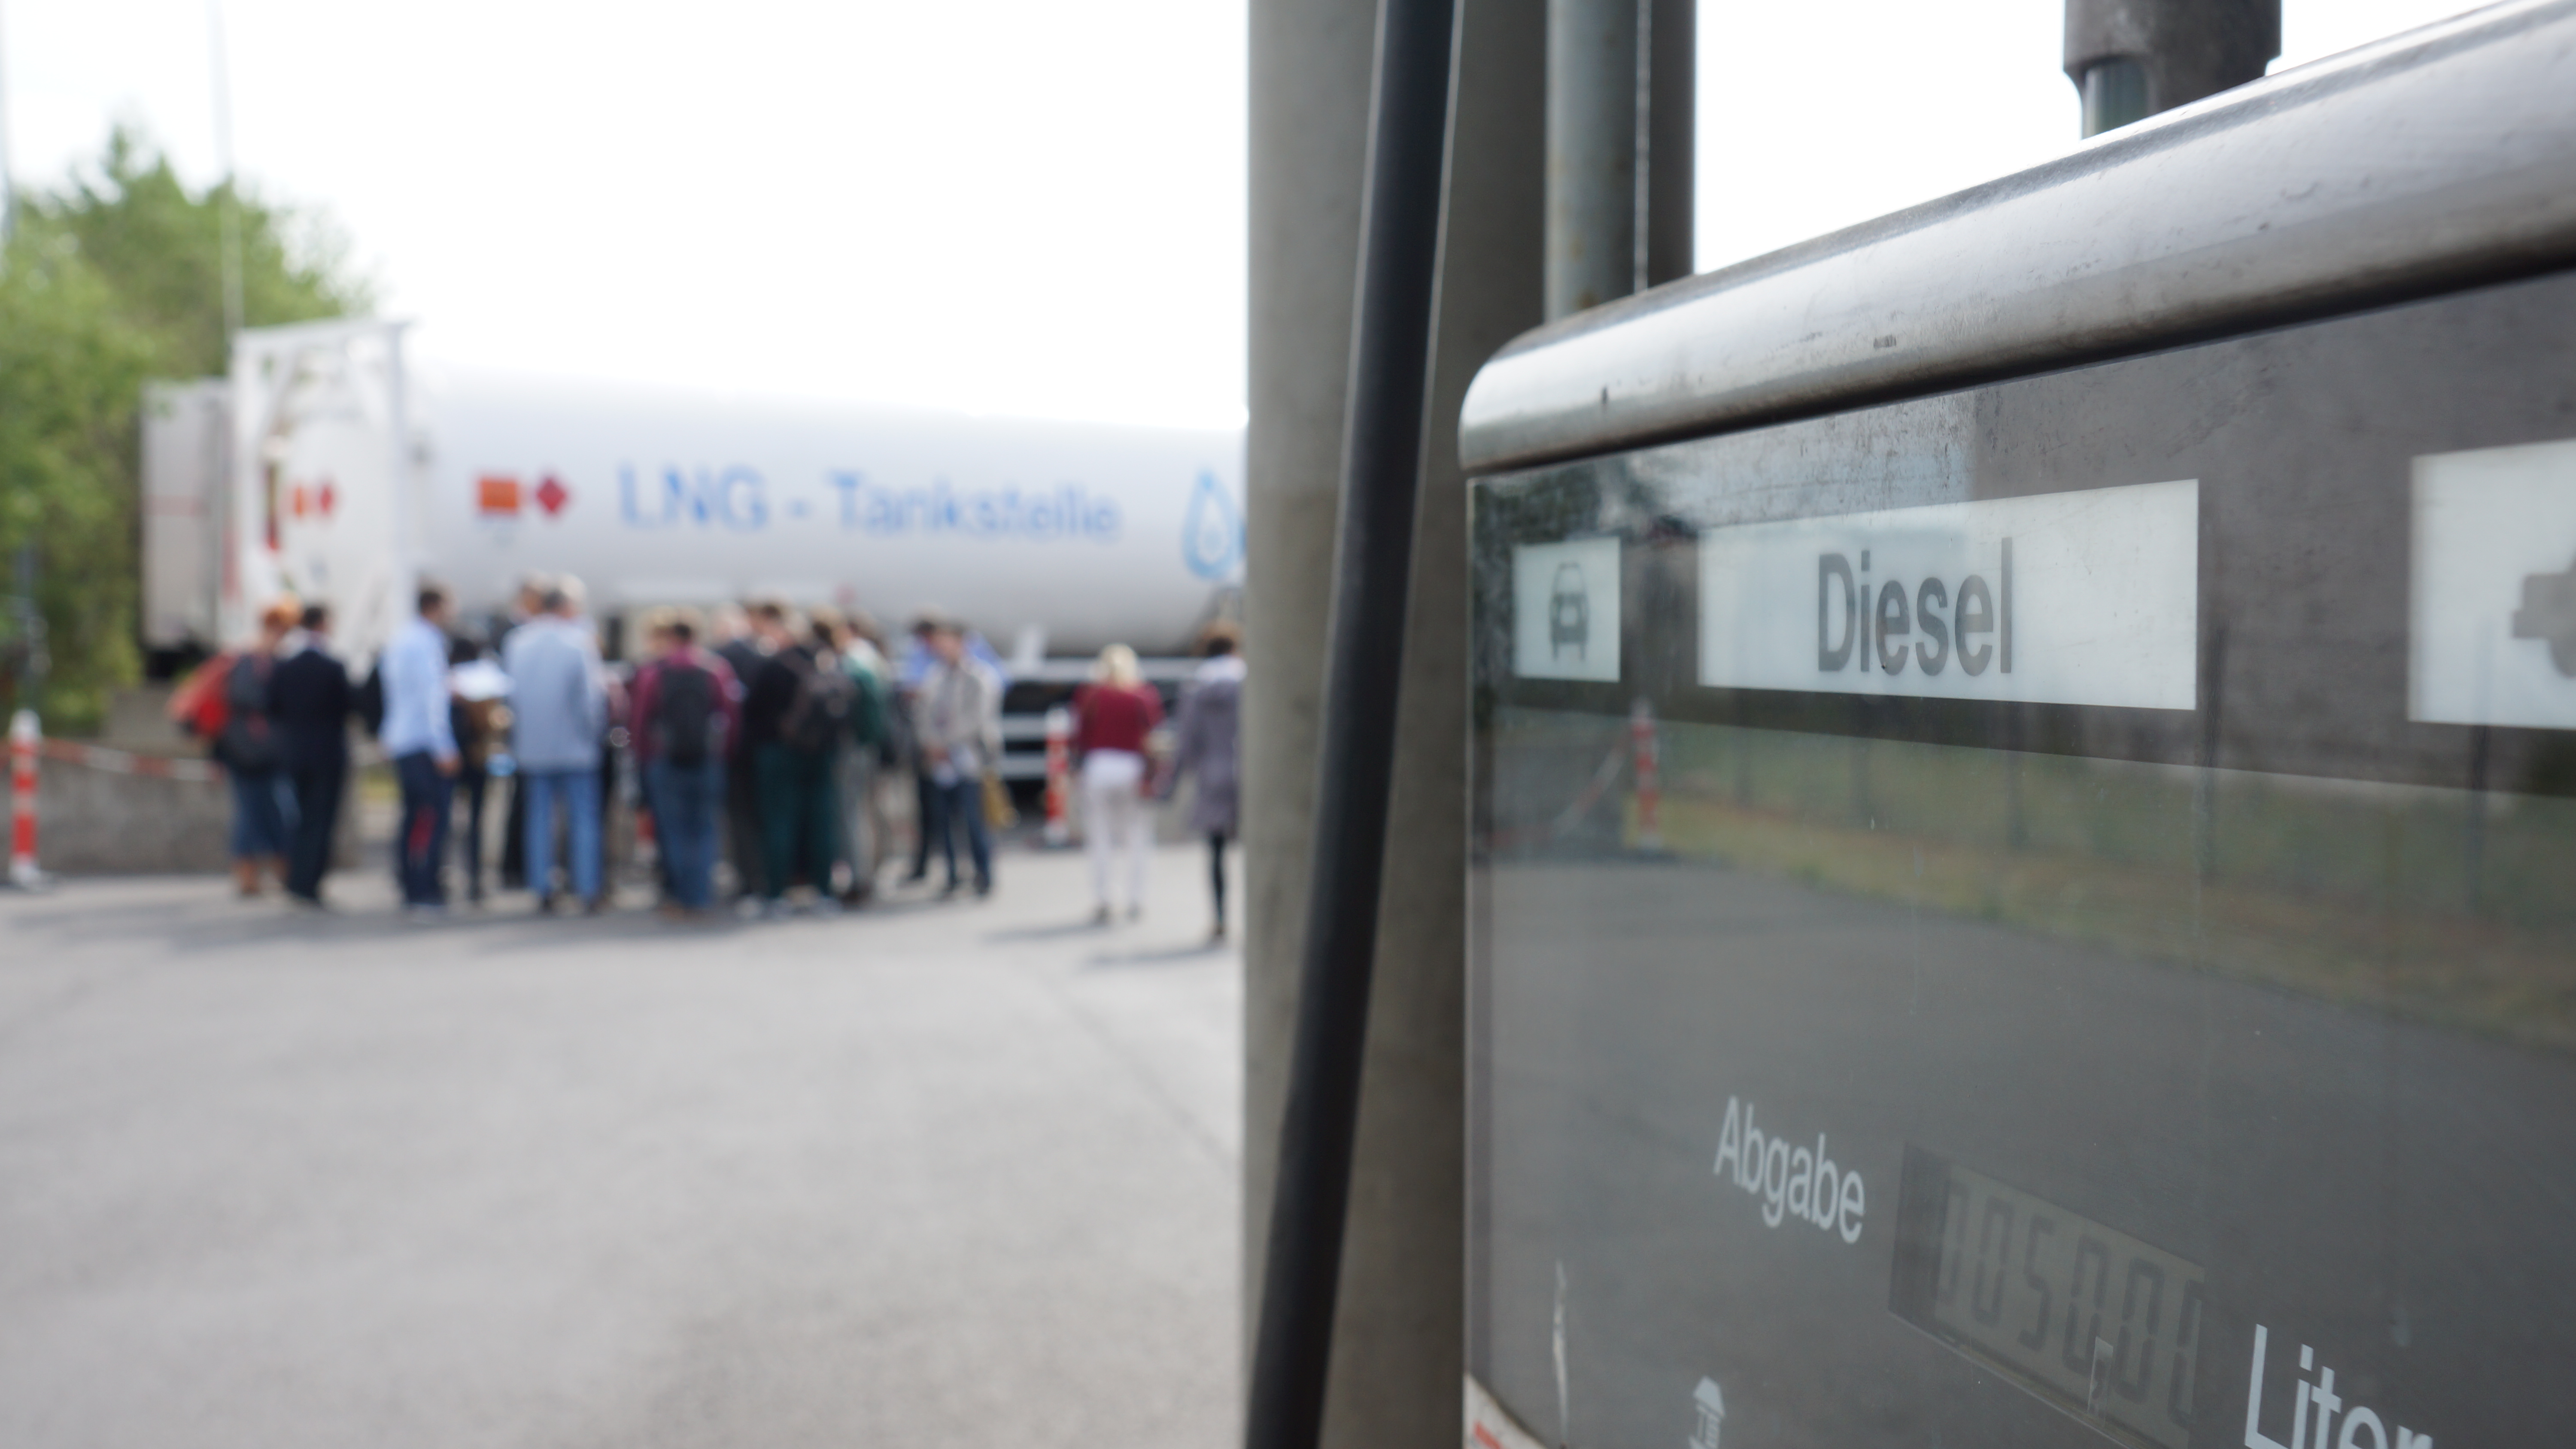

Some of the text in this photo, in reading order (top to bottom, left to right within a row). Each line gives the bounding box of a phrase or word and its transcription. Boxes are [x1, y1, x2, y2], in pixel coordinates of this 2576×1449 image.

[619, 463, 767, 531] LNG
[827, 469, 1123, 541] Tankstelle
[1818, 537, 2012, 677] Diesel
[1713, 1094, 1865, 1243] Abgabe
[2244, 1323, 2433, 1449] Lit
